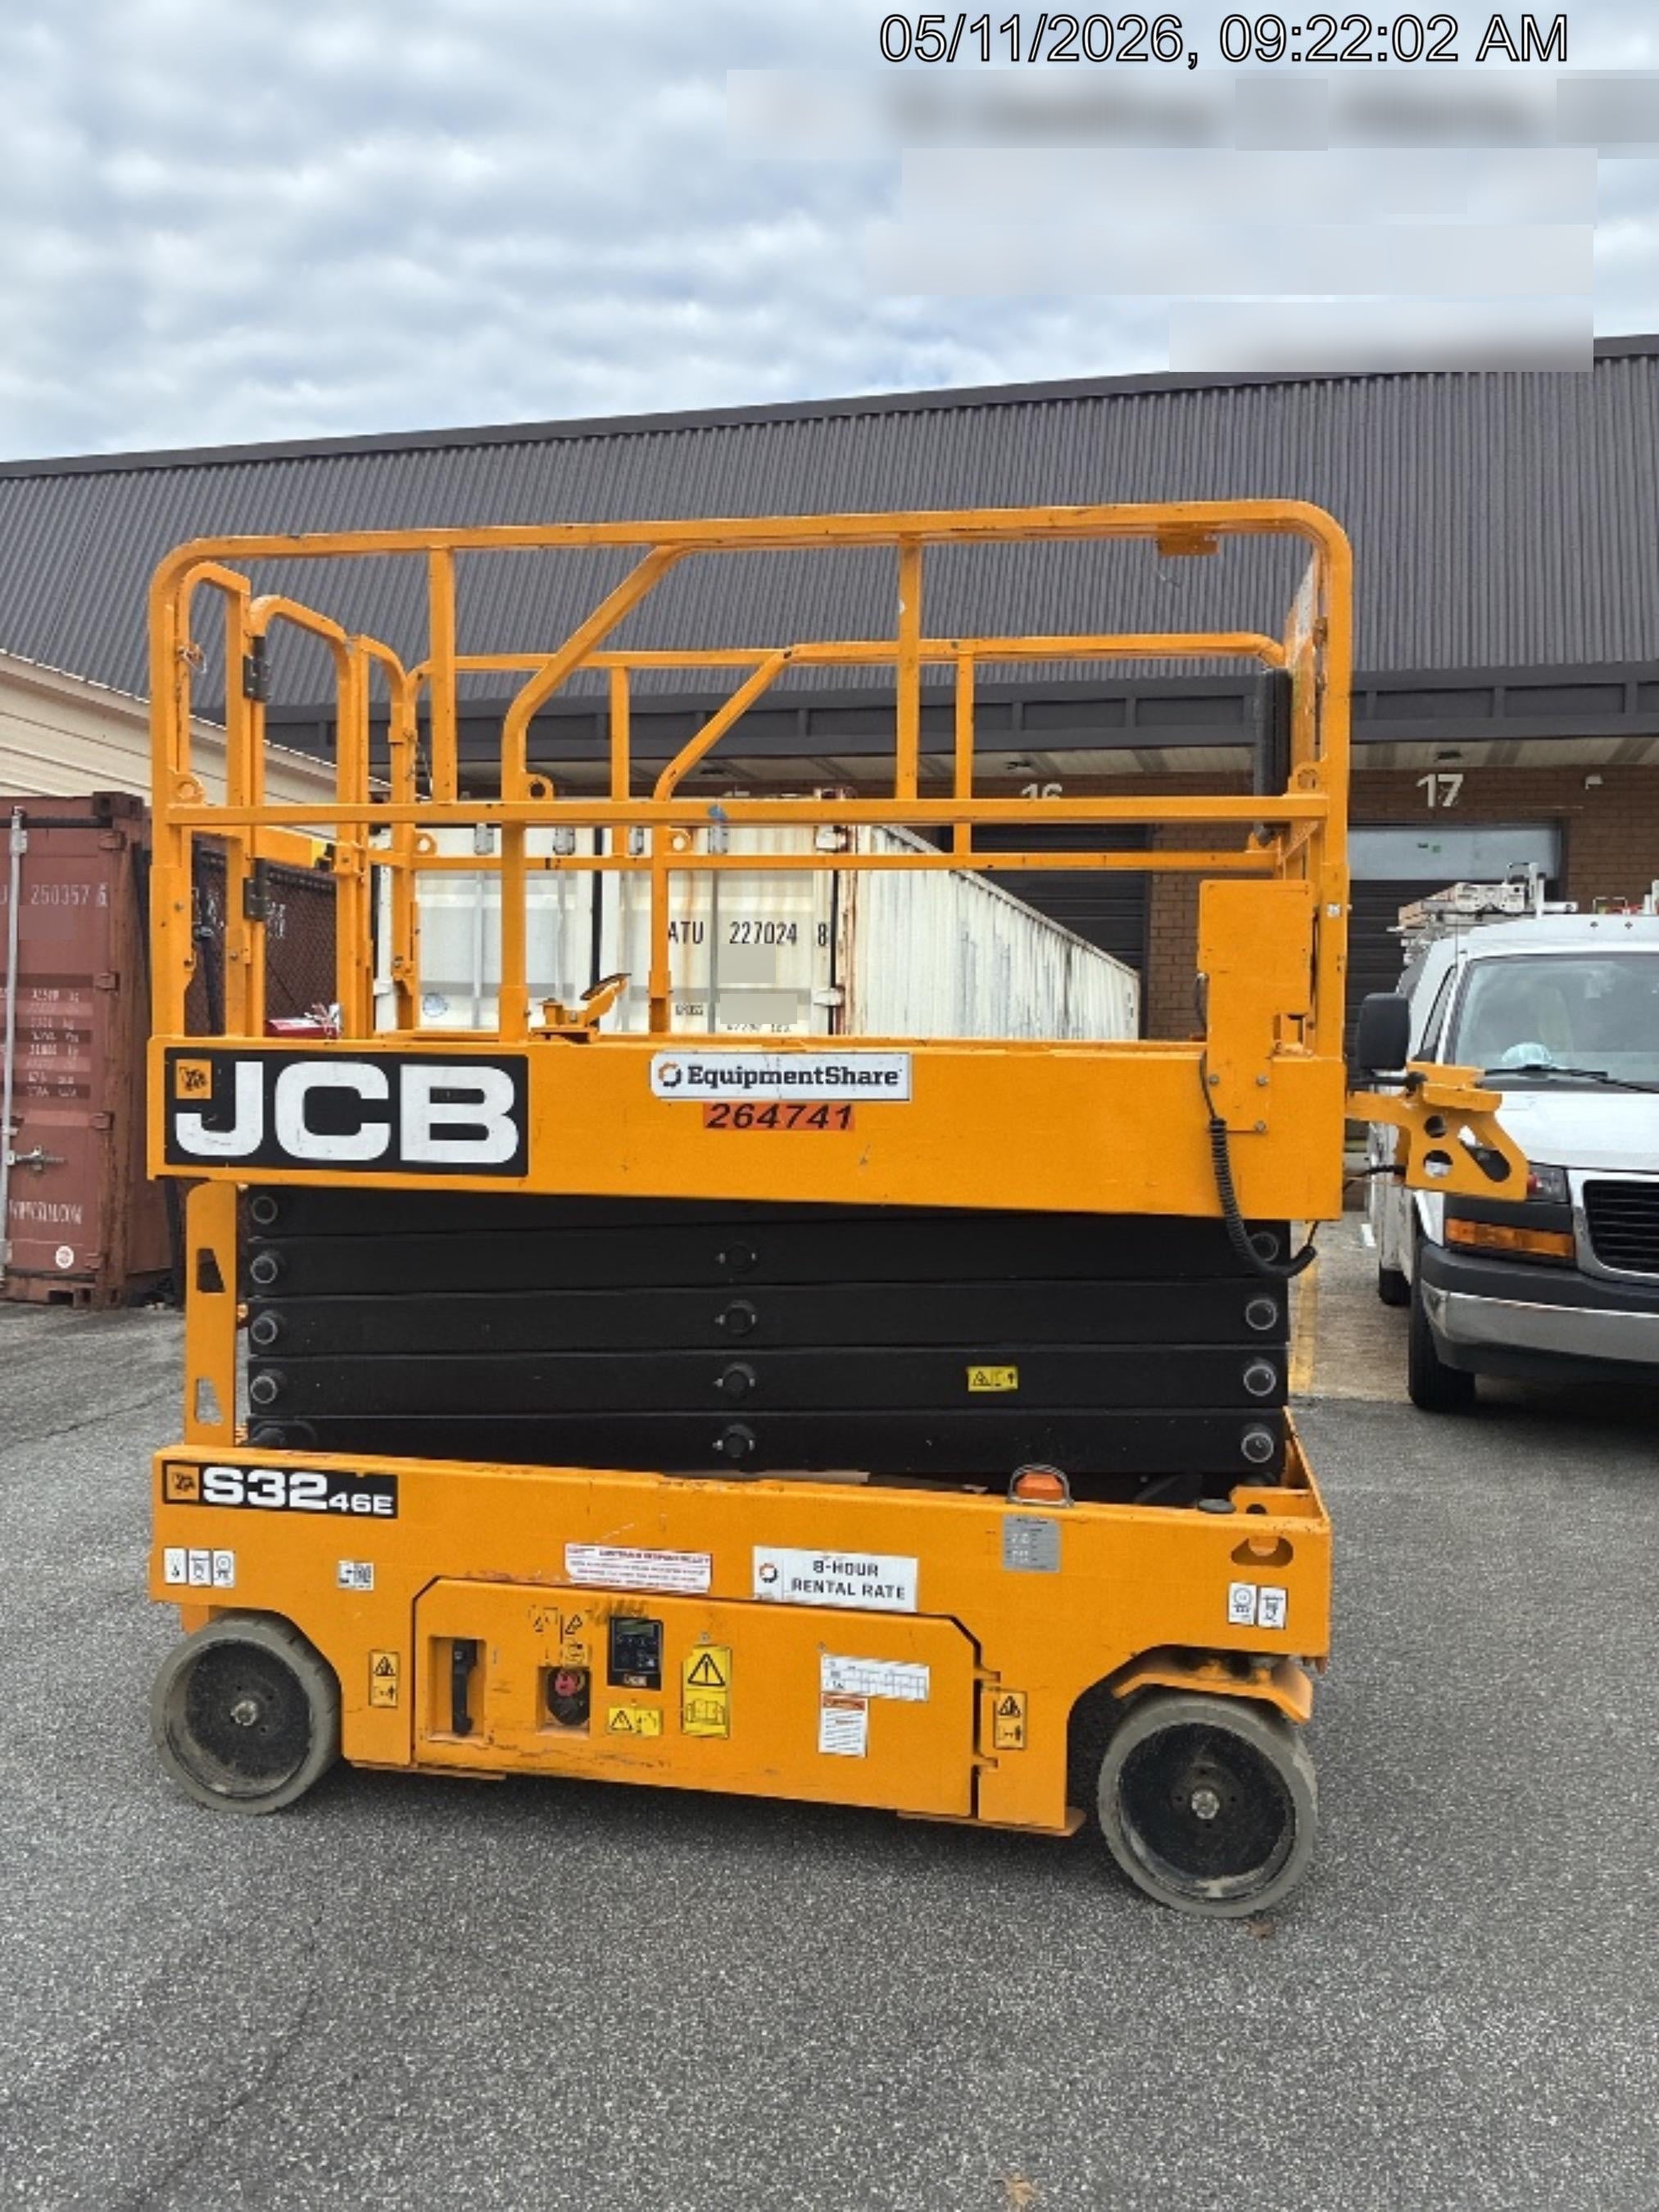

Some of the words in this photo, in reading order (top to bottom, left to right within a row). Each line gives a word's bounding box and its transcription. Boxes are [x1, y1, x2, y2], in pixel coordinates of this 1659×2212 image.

[1416, 773, 1463, 808] 17
[31, 884, 90, 905] 250357
[669, 921, 705, 945] ATU
[729, 921, 797, 945] 227024
[818, 923, 827, 946] 8
[687, 1065, 900, 1090] EquipmentShare
[175, 1060, 520, 1163] JCB
[705, 1103, 853, 1130] 264741
[813, 1559, 879, 1578] 8-HOUR
[791, 1577, 856, 1596] RENTAL
[862, 1584, 906, 1600] RATE
